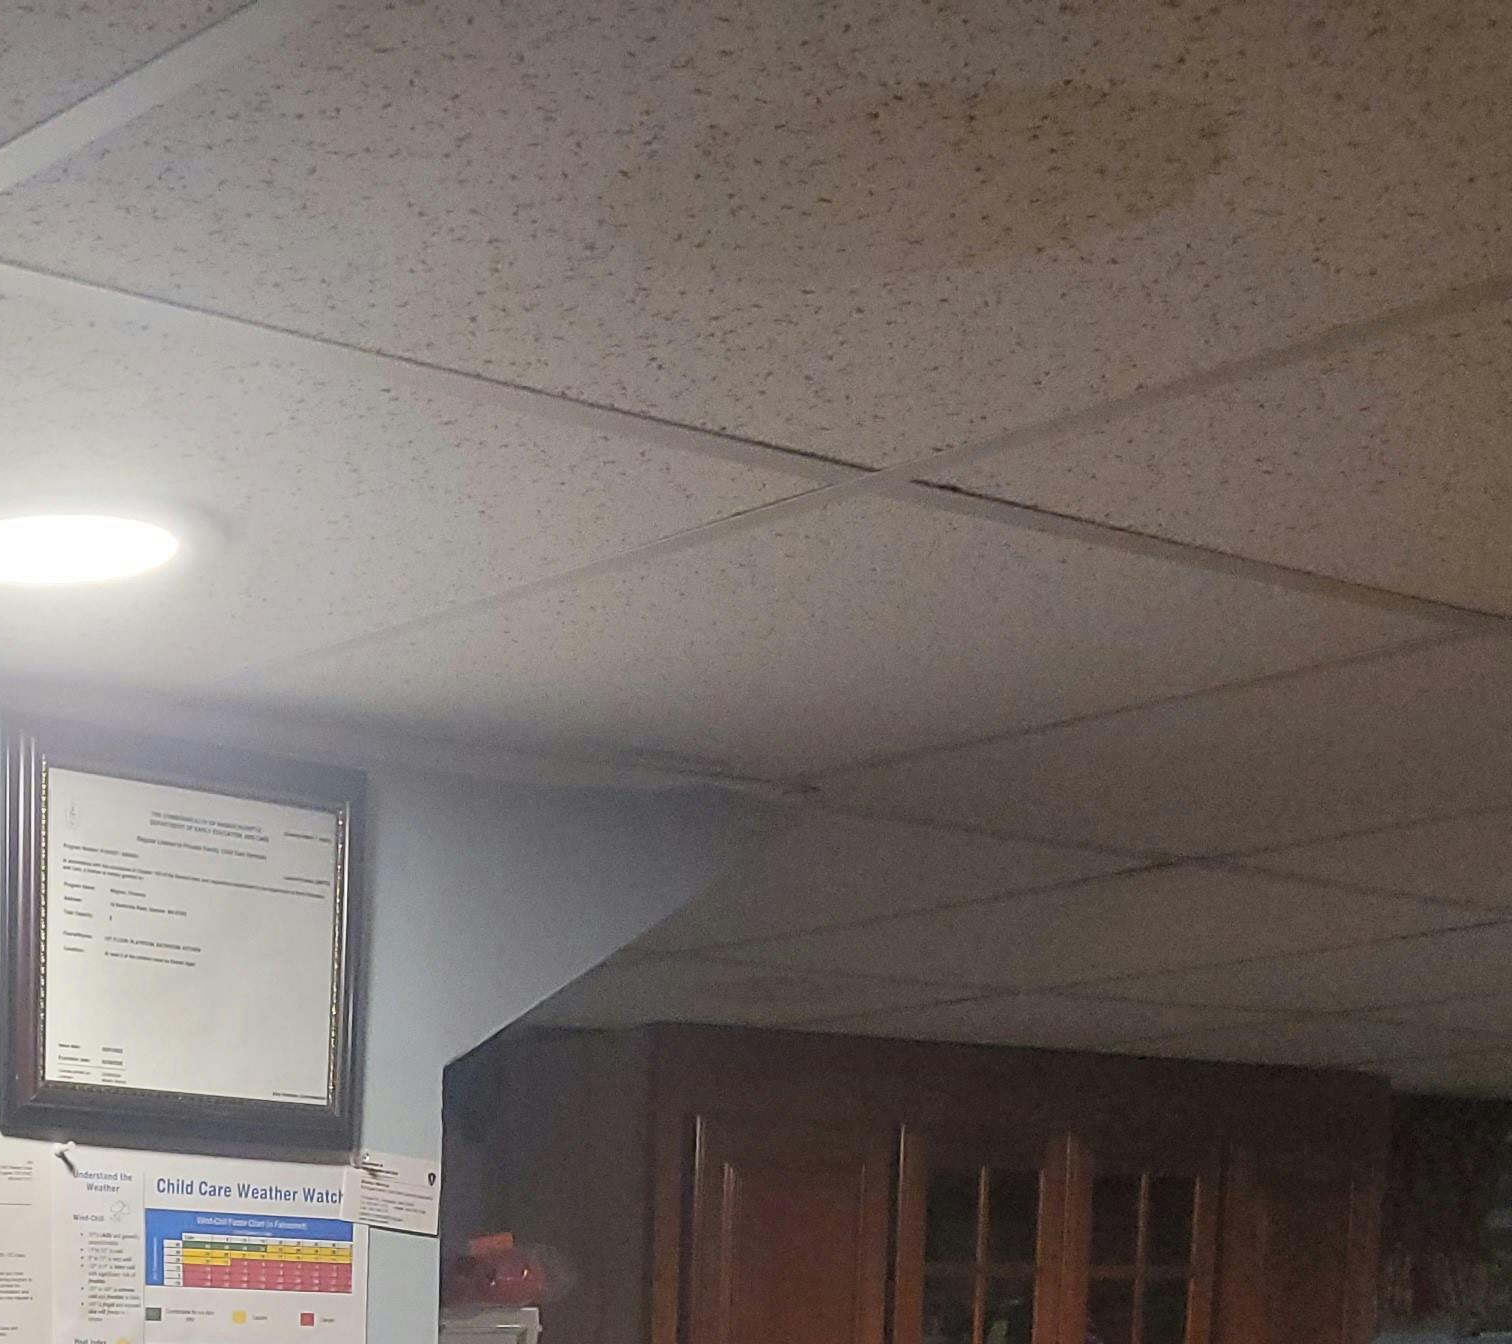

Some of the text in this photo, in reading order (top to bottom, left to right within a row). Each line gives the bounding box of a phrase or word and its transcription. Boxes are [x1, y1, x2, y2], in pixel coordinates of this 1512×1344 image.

[120, 1172, 132, 1181] the
[87, 1184, 120, 1192] Weather
[157, 1178, 193, 1195] Child
[198, 1181, 231, 1197] Care
[237, 1184, 297, 1202] Weather
